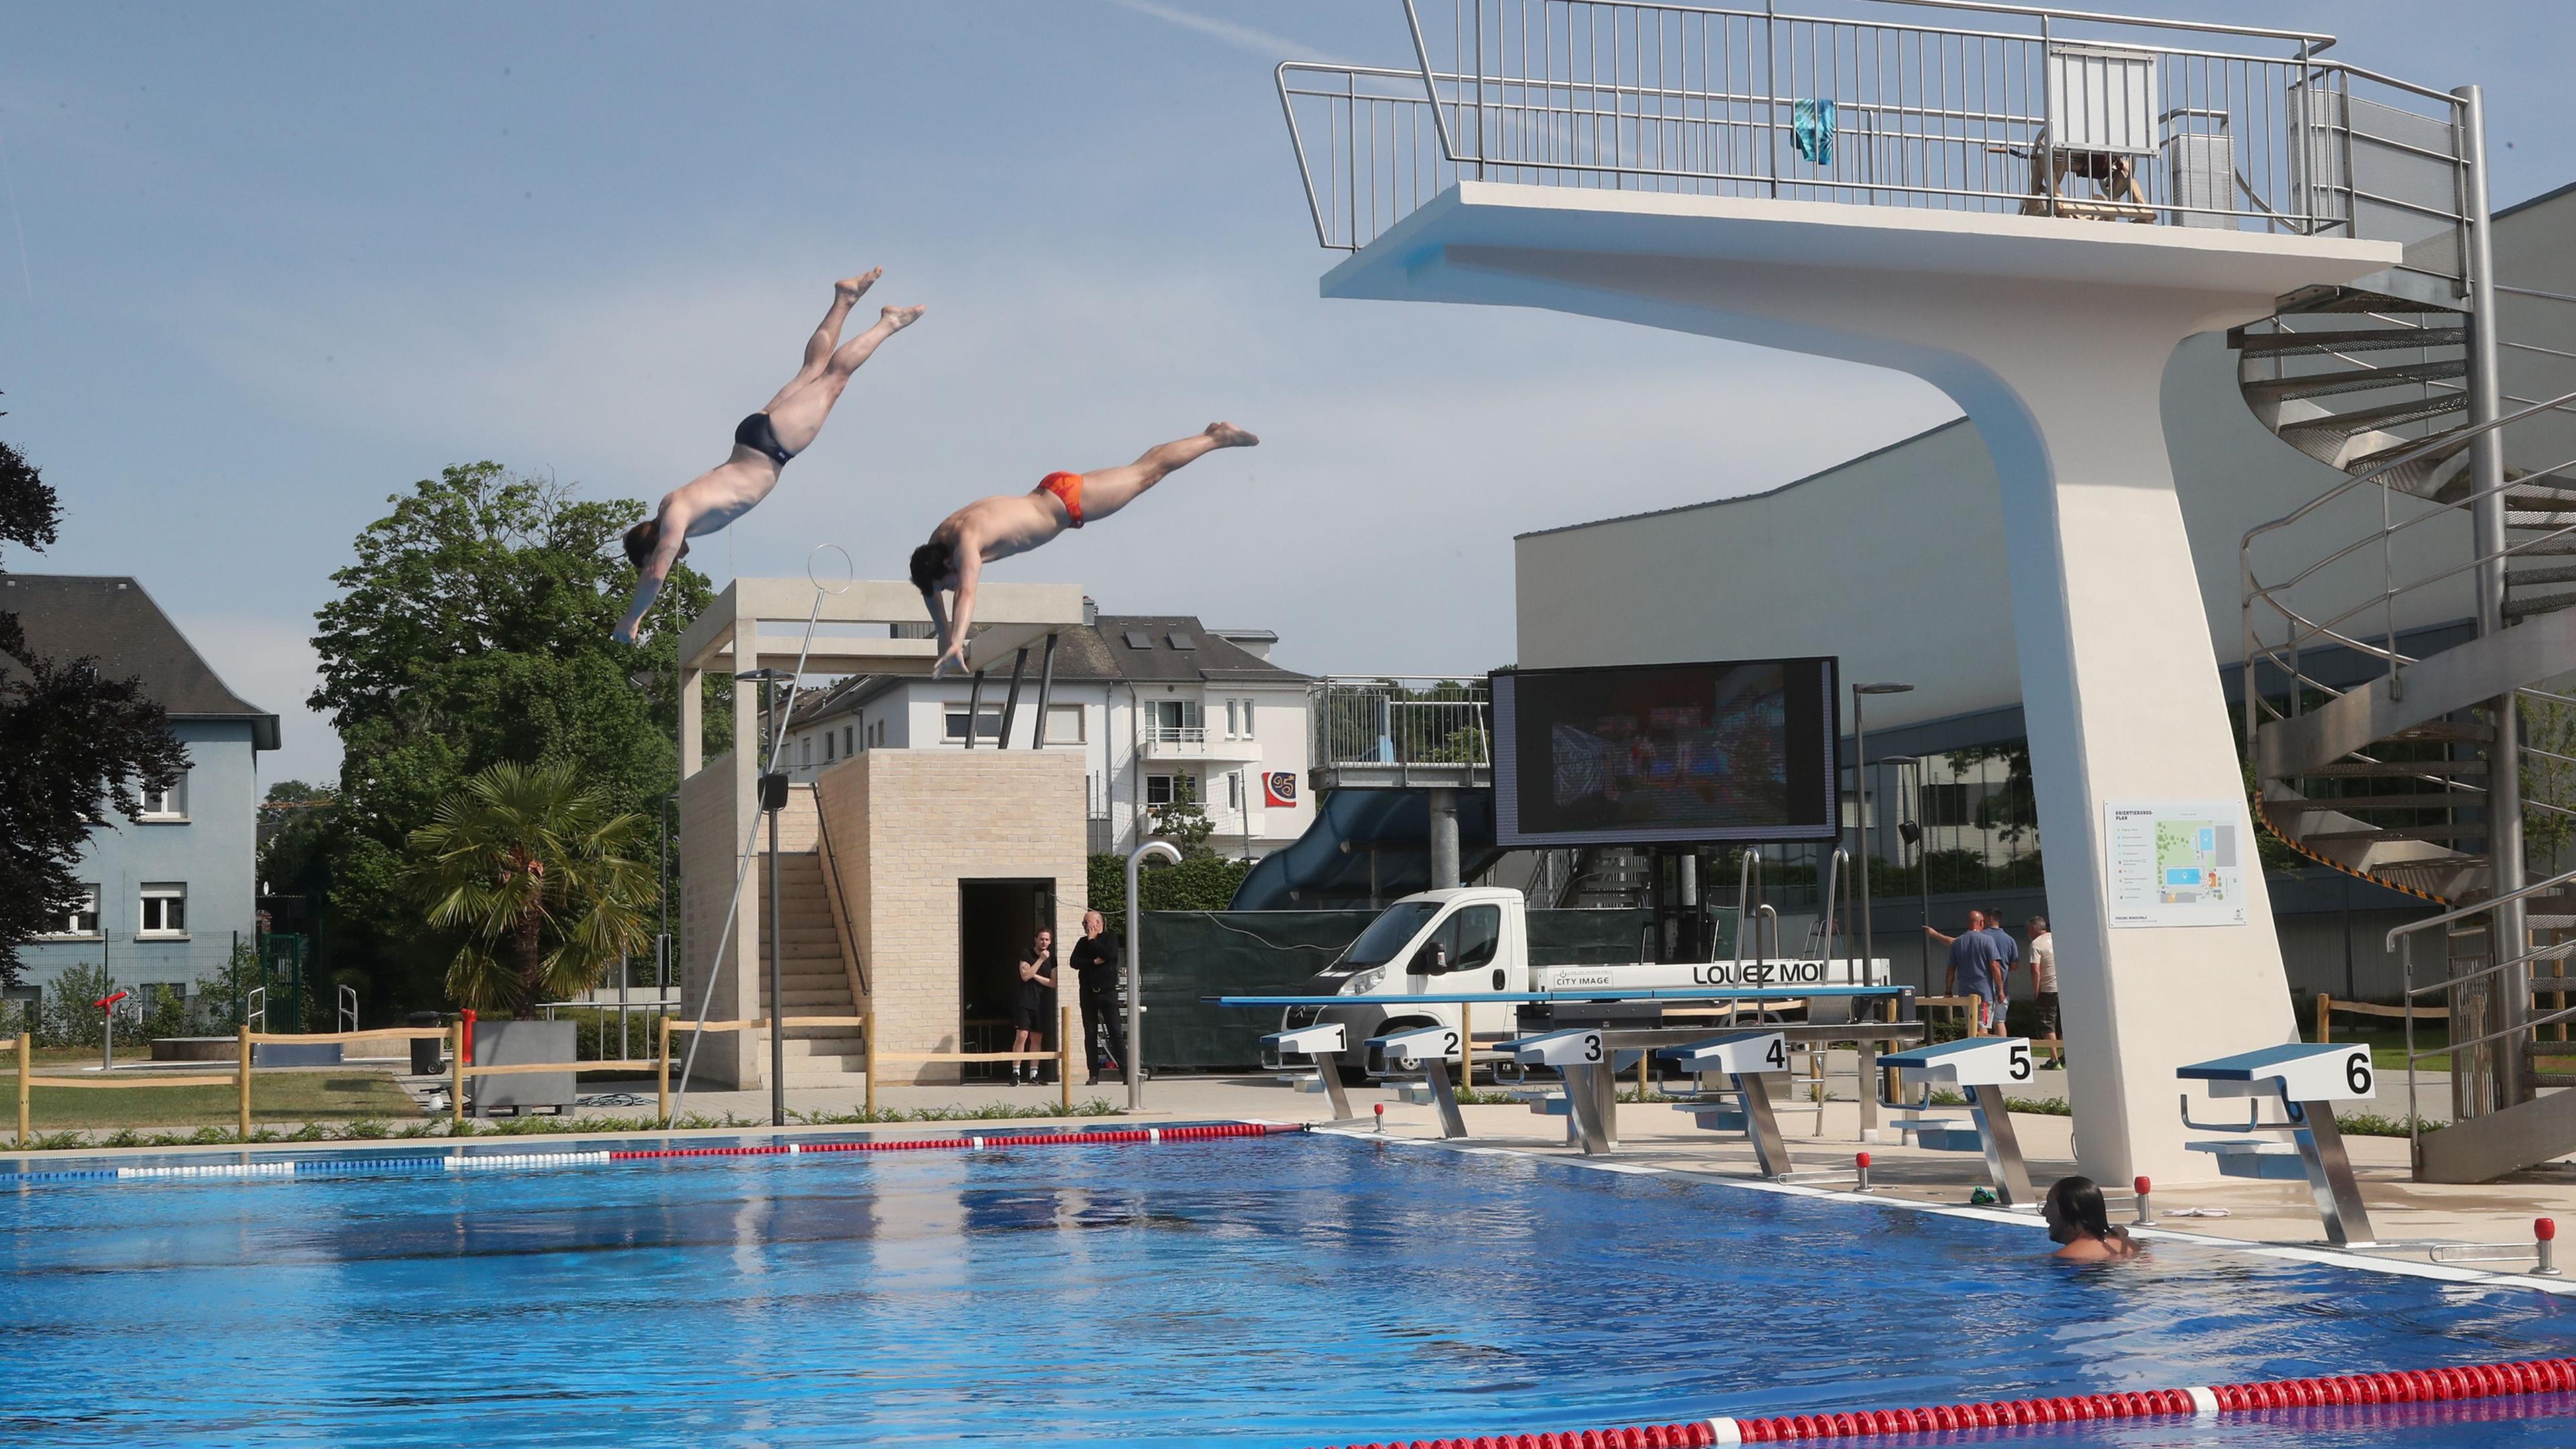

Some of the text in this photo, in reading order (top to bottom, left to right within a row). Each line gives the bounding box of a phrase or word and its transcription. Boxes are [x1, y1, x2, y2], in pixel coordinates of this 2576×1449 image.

[1579, 977, 1609, 985] IMAGE
[1693, 965, 1774, 985] LOUEZ
[1336, 1028, 1345, 1050] 1
[1444, 1032, 1459, 1055] 2
[1585, 1034, 1602, 1062] 3
[1766, 1038, 1786, 1069] 4
[2009, 1045, 2031, 1080] 5
[2346, 1053, 2371, 1094] 6
